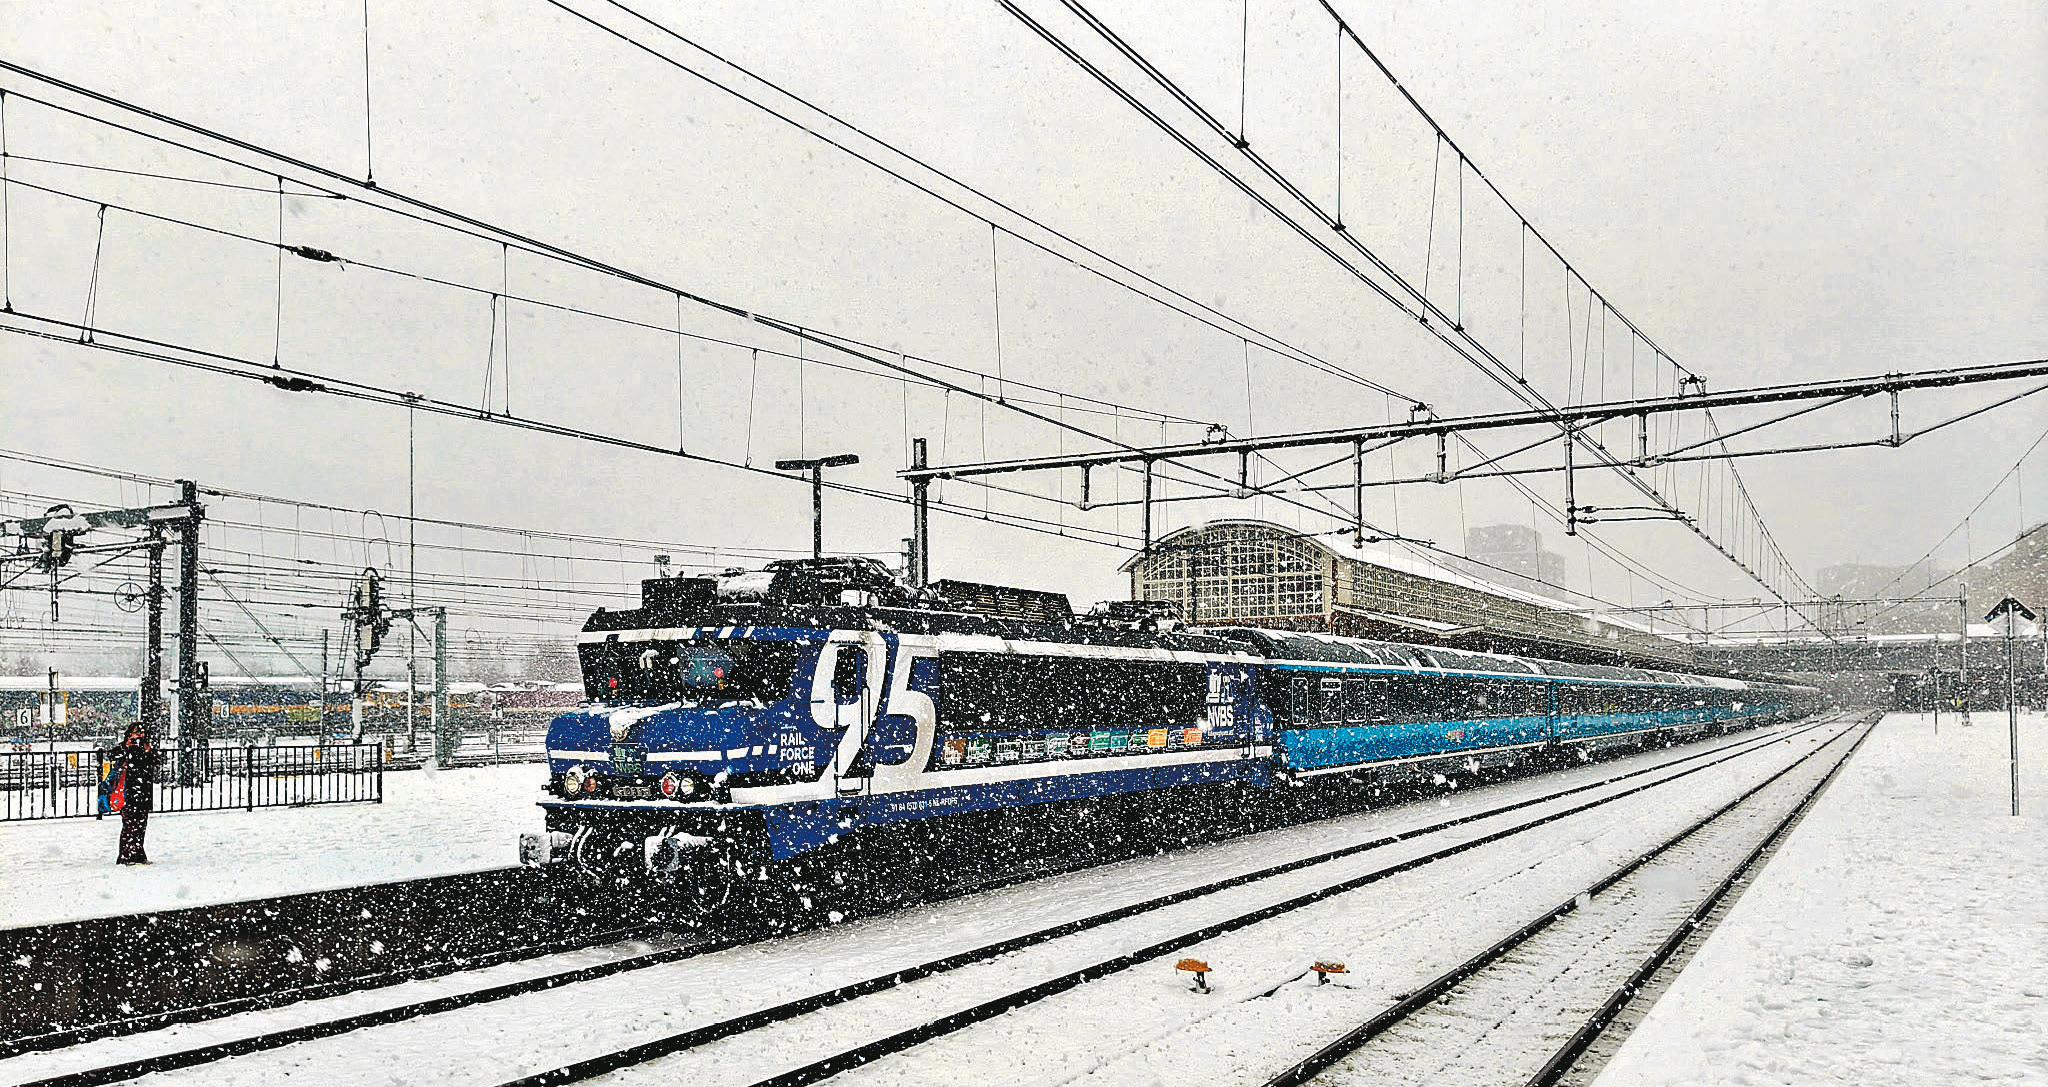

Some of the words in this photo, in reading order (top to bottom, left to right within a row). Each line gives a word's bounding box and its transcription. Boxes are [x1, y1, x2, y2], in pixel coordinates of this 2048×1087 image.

[811, 629, 937, 789] 95
[1207, 704, 1234, 727] NVBS
[20, 710, 29, 725] 6
[780, 732, 806, 746] RAIL
[780, 746, 815, 761] FORCE
[614, 762, 642, 773] NVBS
[792, 760, 815, 775] ONE
